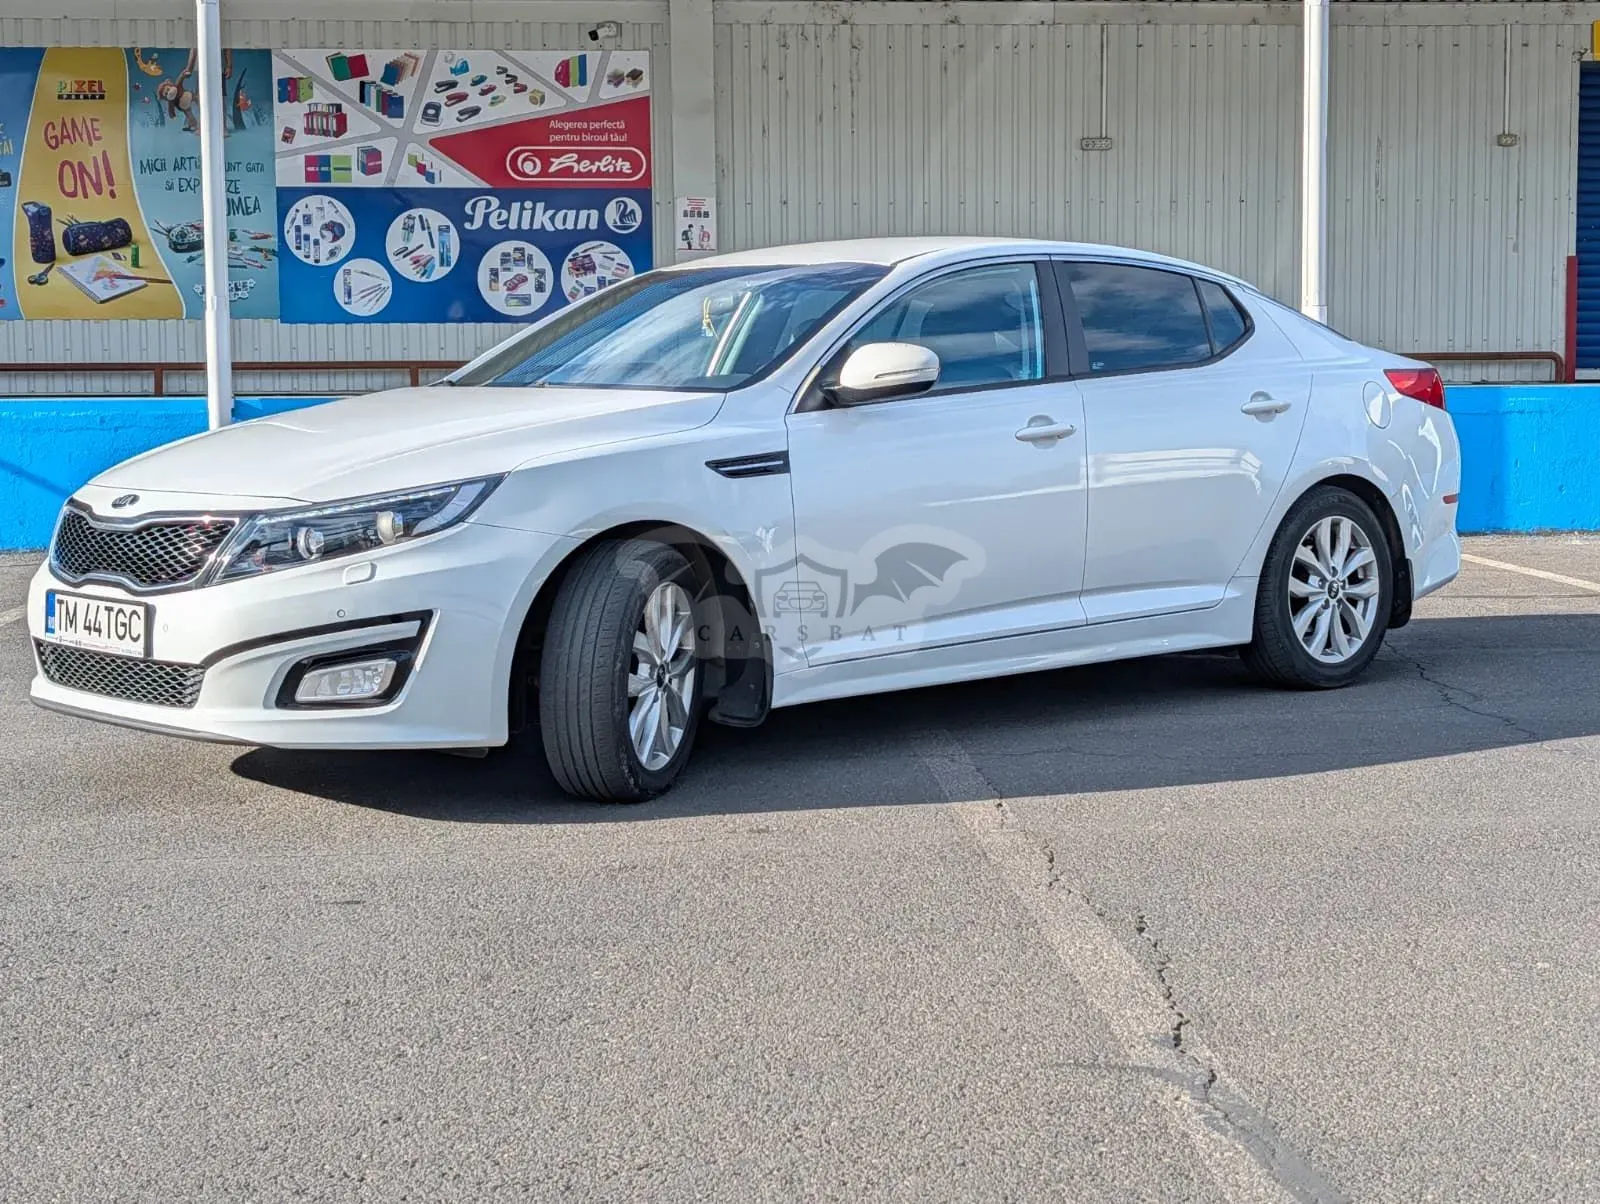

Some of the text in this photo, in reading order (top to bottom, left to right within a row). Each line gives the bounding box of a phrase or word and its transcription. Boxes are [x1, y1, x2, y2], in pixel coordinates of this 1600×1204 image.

[57, 80, 106, 93] PIXEL
[44, 116, 103, 150] GAME
[549, 120, 588, 130] Alegerea
[549, 134, 580, 143] pentru
[582, 133, 609, 142] biroul
[58, 150, 117, 199] ON!
[464, 195, 599, 231] Pelikan
[57, 599, 78, 634] TM
